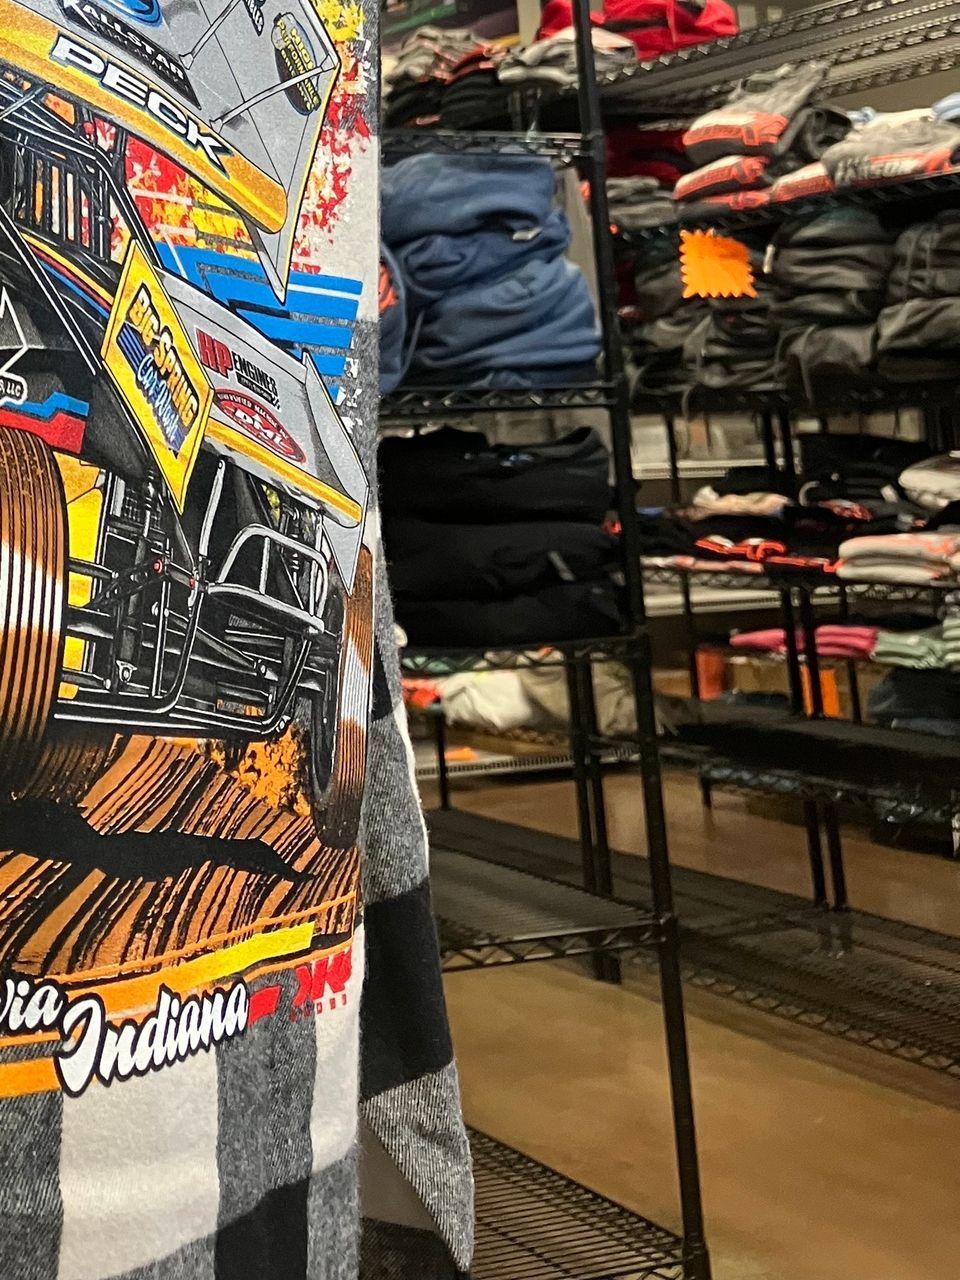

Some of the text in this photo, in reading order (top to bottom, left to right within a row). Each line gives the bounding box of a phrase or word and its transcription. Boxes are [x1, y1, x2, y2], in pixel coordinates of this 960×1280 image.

[82, 5, 184, 80] ALLSTAR
[52, 35, 226, 172] PECK
[6, 380, 22, 397] LLC
[128, 287, 198, 428] BIG SPRING
[195, 328, 233, 379] HP
[57, 983, 251, 1093] Indiana
